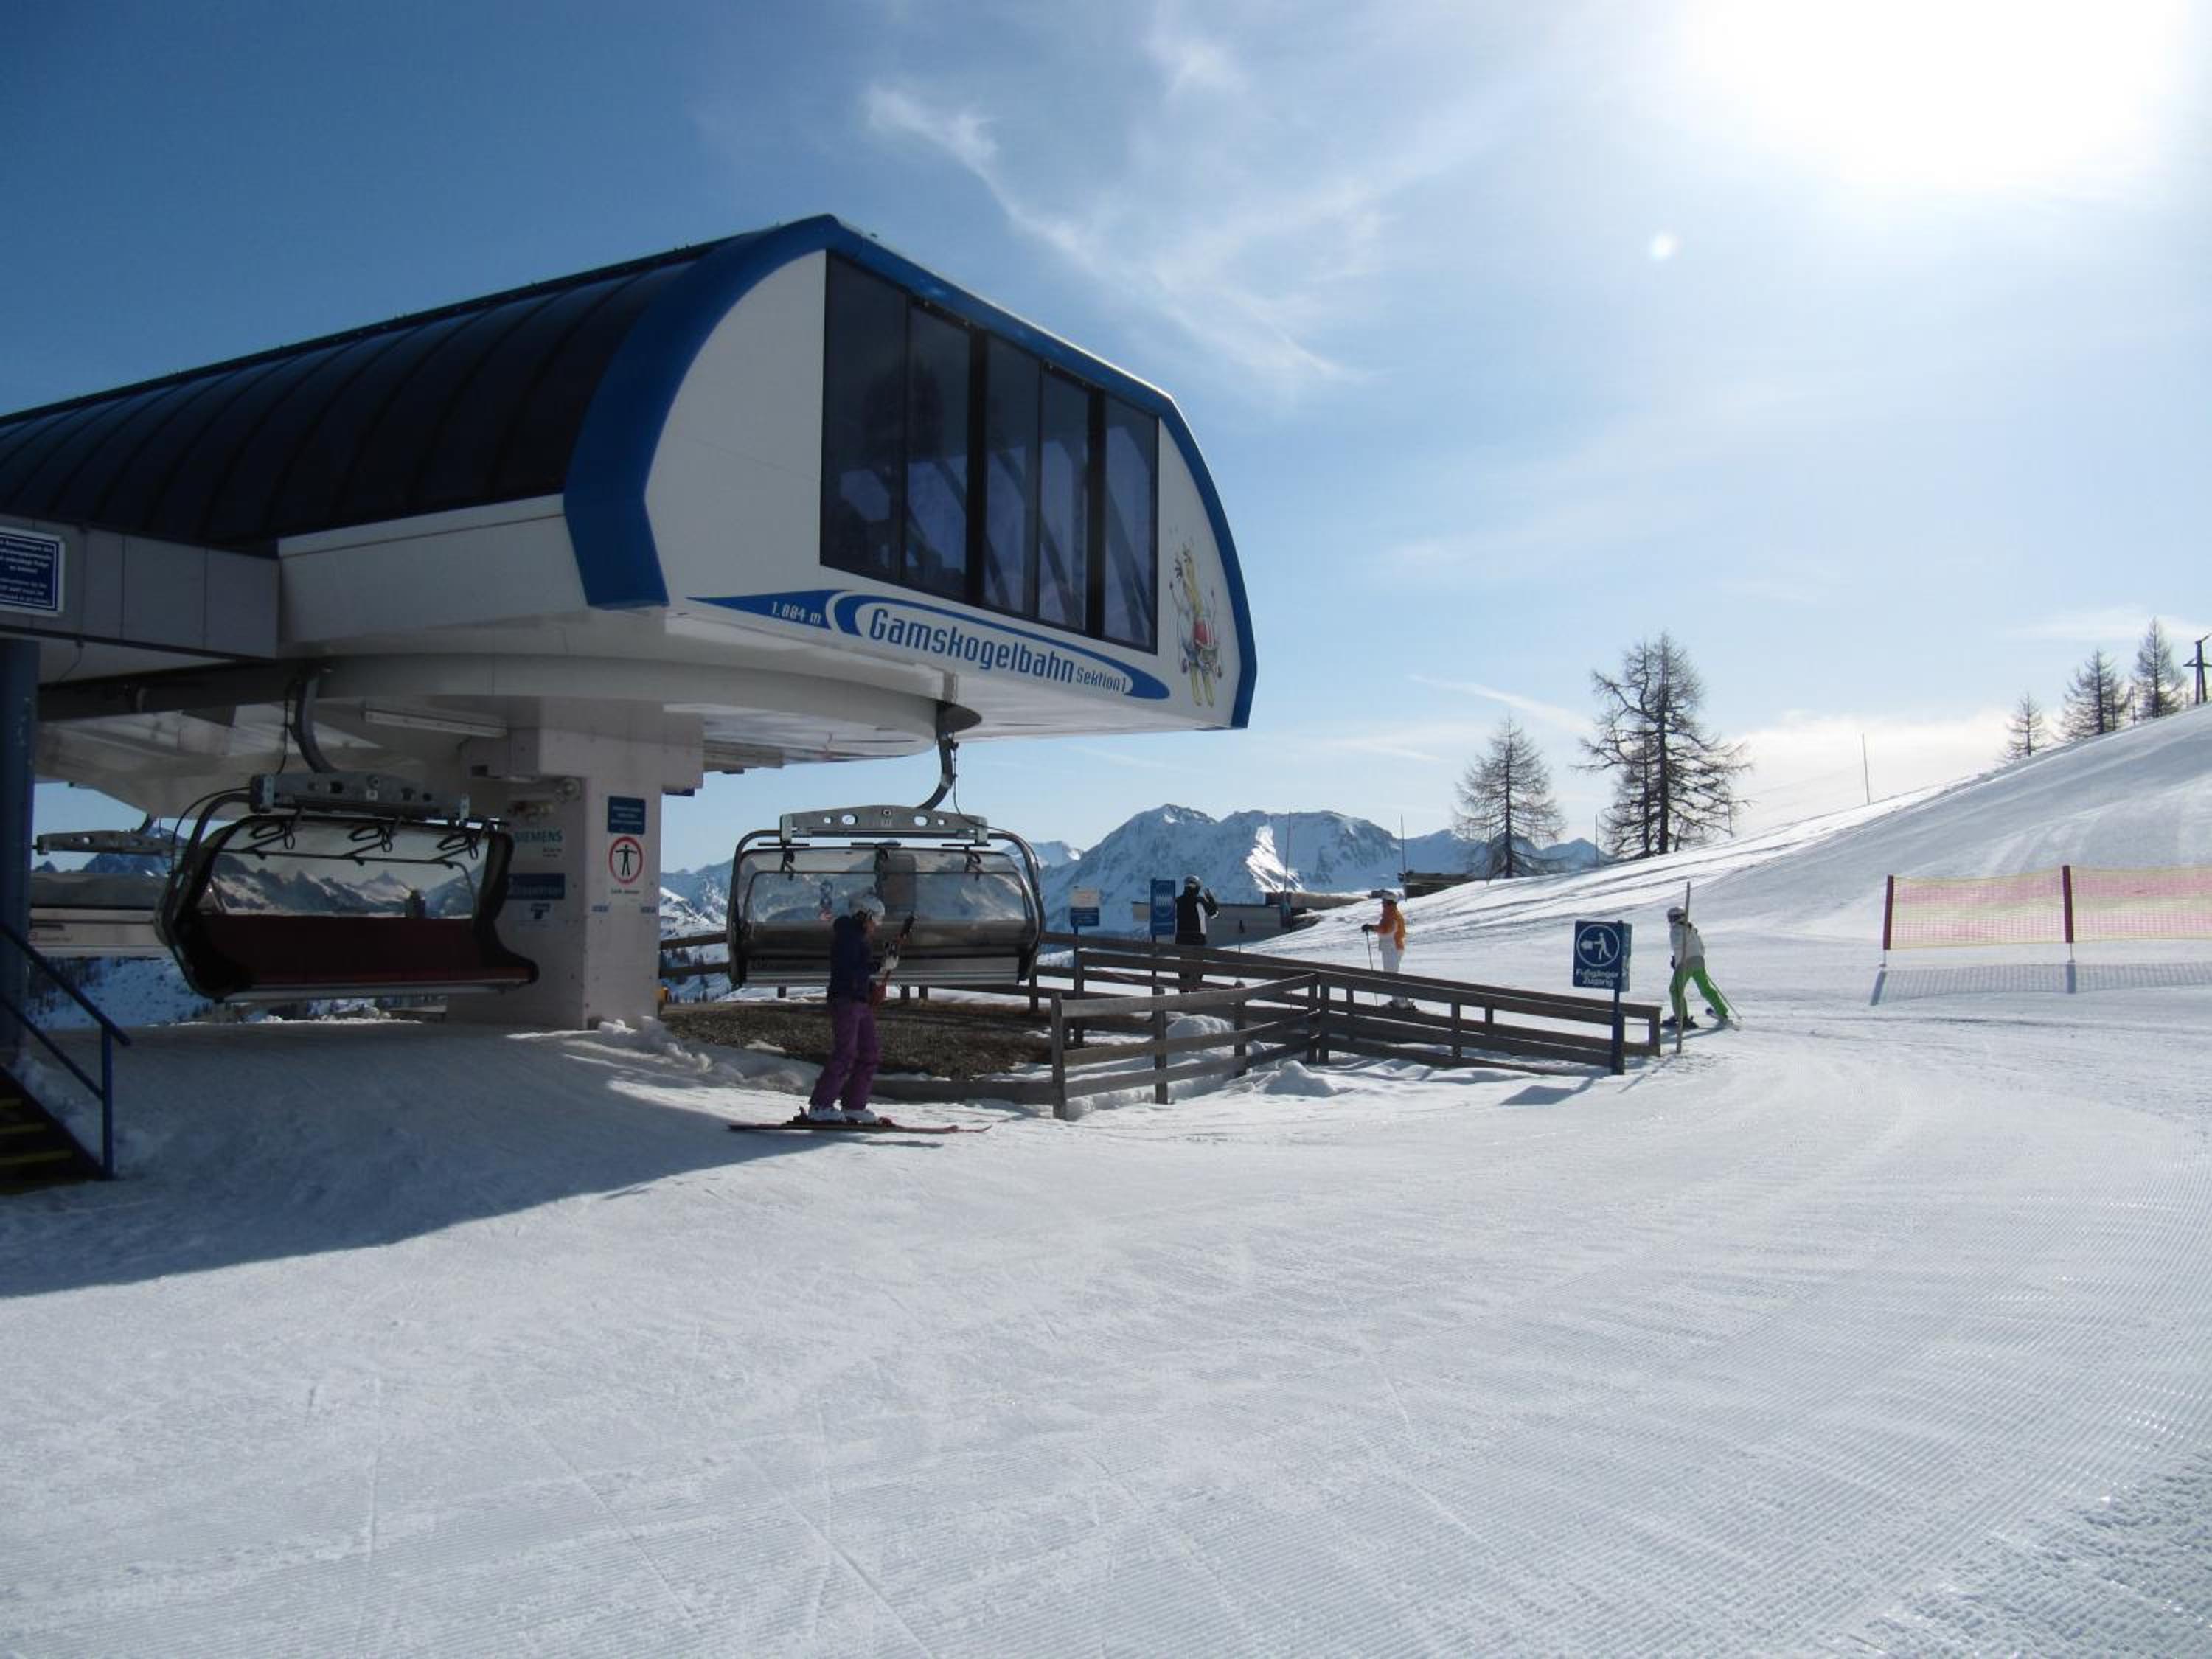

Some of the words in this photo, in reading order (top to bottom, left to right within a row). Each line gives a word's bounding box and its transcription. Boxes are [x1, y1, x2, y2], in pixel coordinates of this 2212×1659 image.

[810, 612, 822, 625] m
[869, 608, 1074, 684] Gamskogelbahn
[1077, 667, 1120, 691] Sektion
